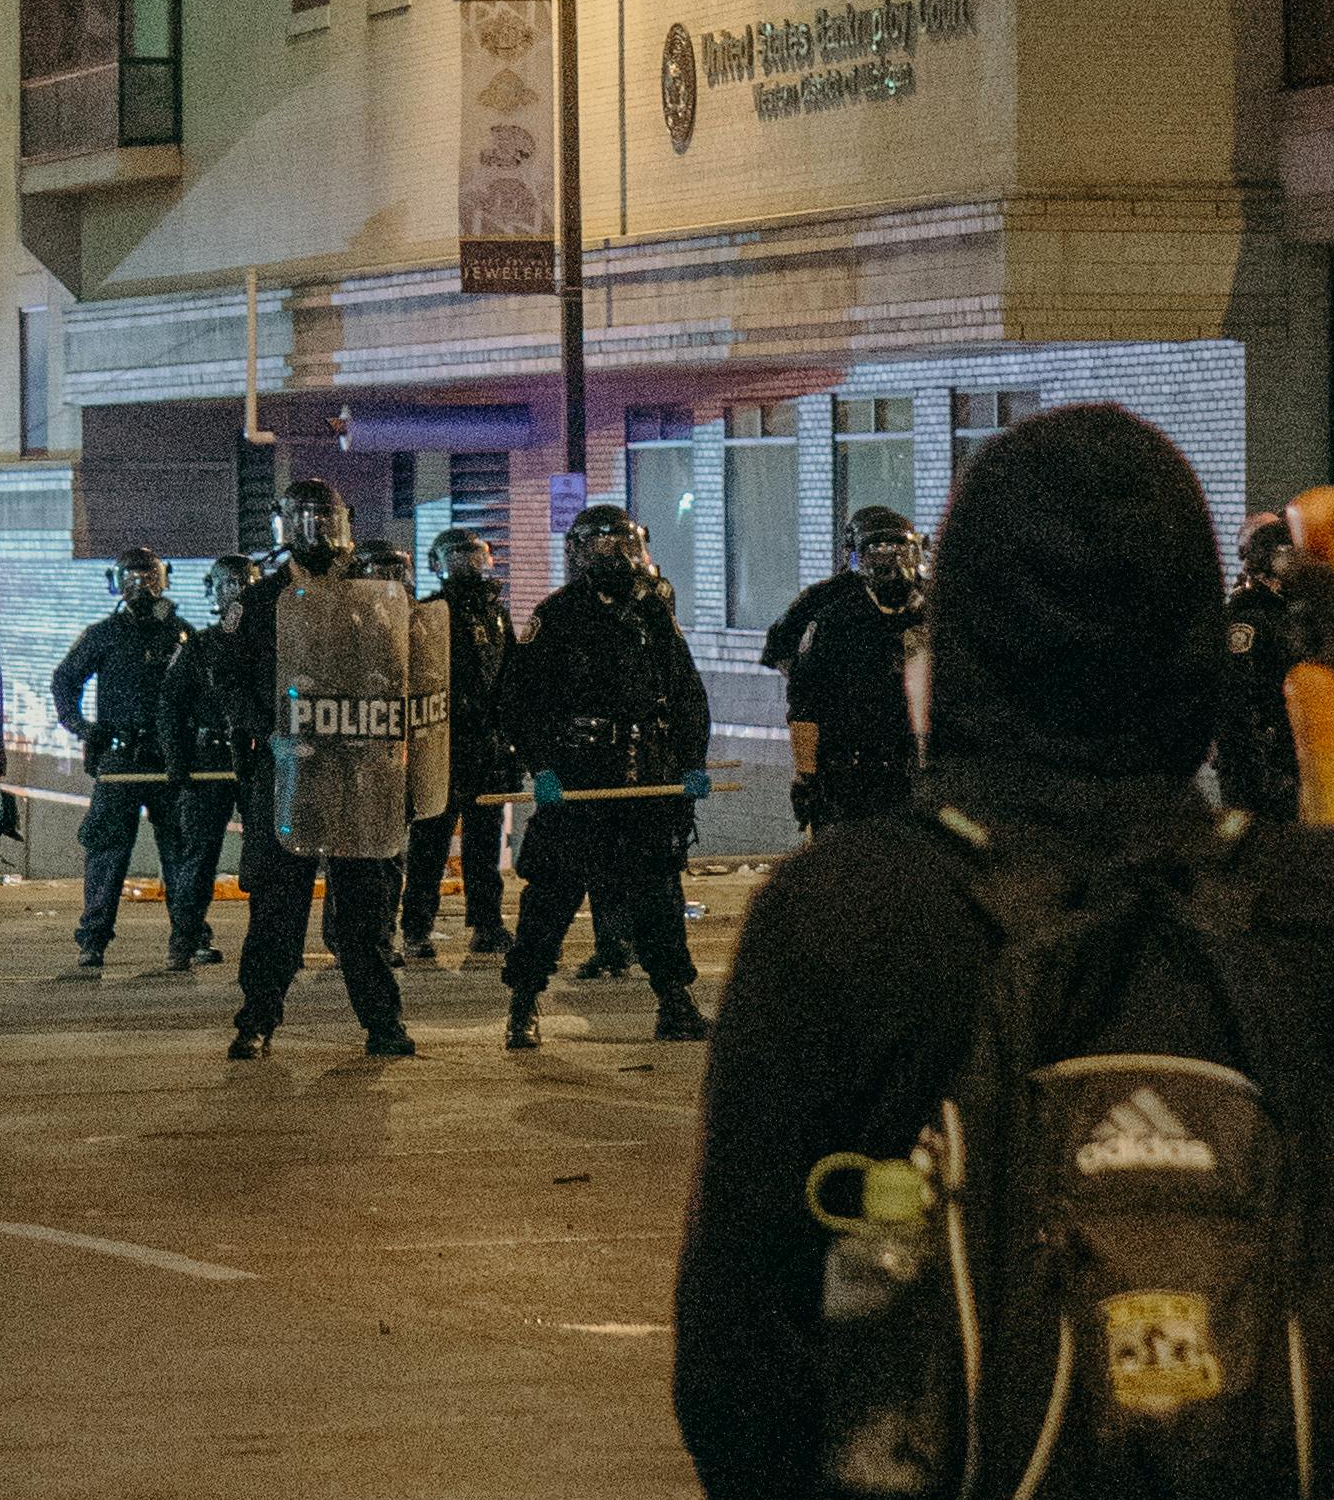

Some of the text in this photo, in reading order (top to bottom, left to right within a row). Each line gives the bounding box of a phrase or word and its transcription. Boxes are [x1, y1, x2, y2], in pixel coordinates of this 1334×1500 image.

[463, 267, 553, 281] JEWELERS
[290, 699, 401, 736] POLICE
[410, 690, 447, 727] LICE
